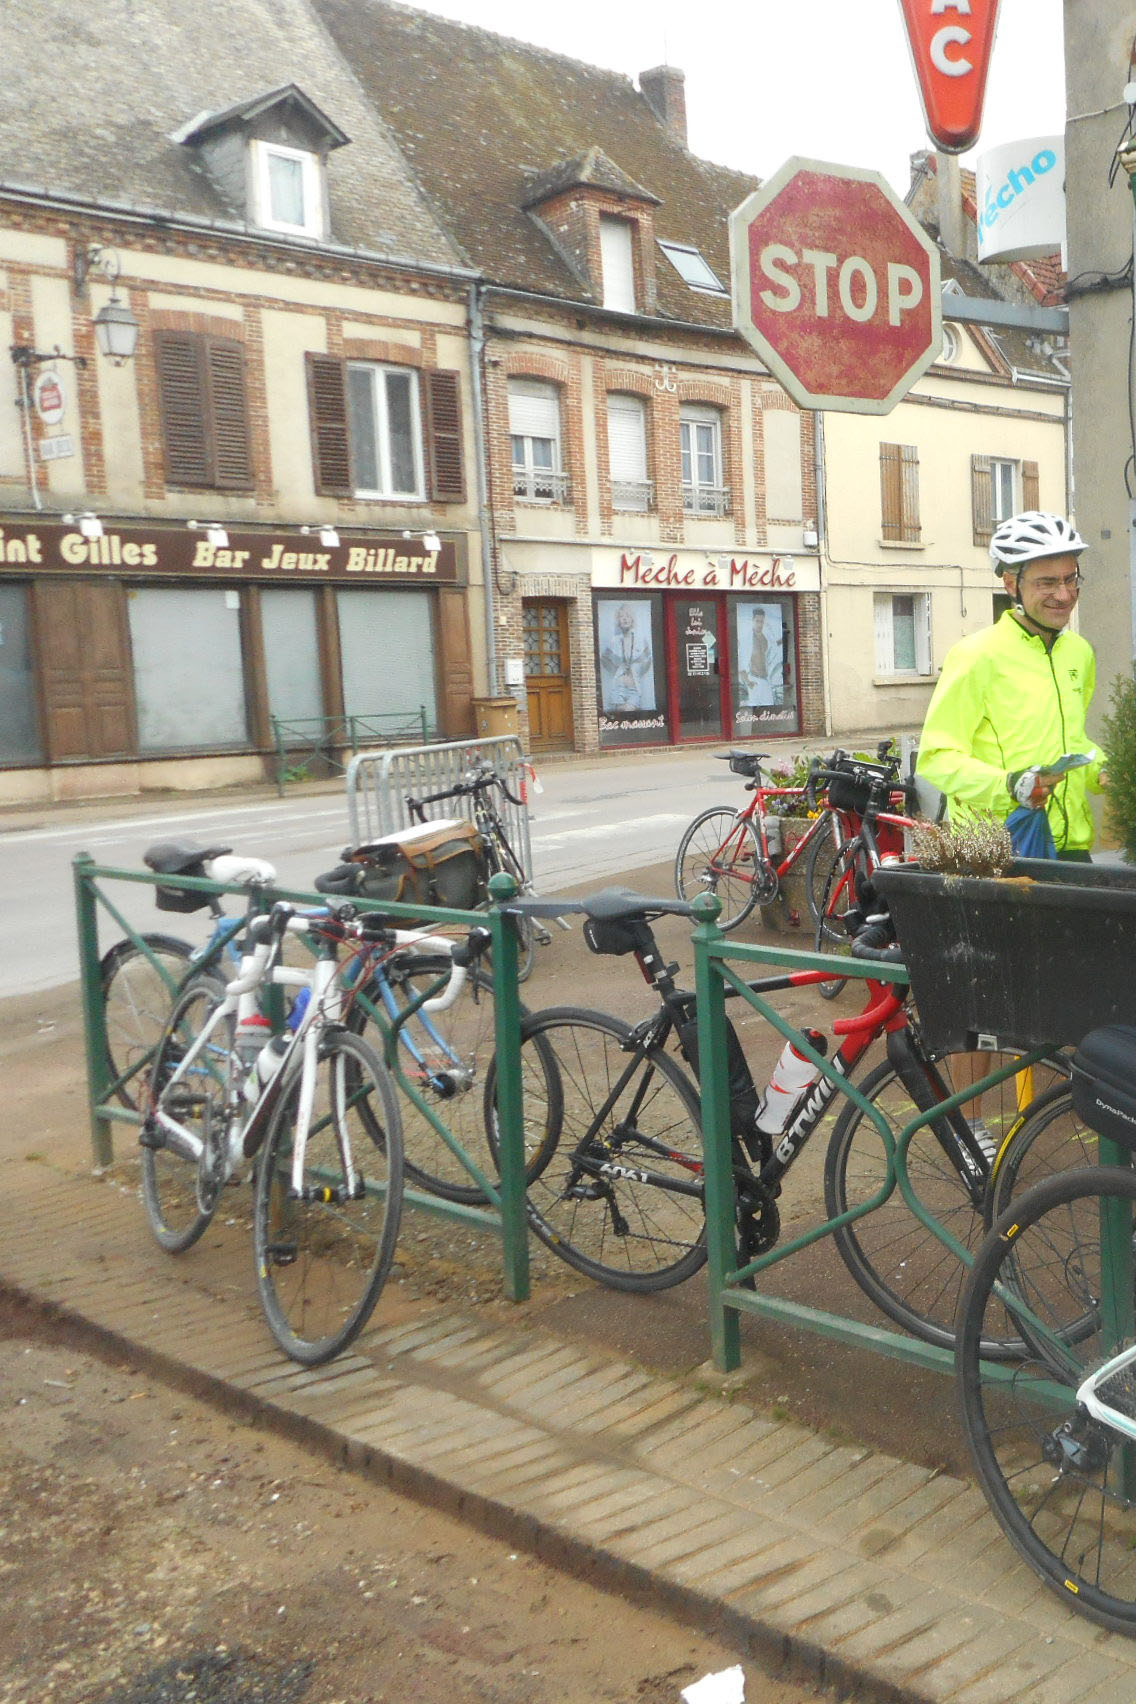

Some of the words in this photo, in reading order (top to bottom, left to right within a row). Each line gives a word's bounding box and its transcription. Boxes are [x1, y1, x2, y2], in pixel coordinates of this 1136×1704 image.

[930, 0, 973, 77] C
[760, 243, 923, 327] STOP
[60, 533, 158, 565] Gilles
[192, 541, 250, 569] Bar
[261, 544, 332, 570] Jeux
[346, 547, 438, 573] Billard
[703, 561, 720, 586] à
[730, 557, 796, 587] Mèche
